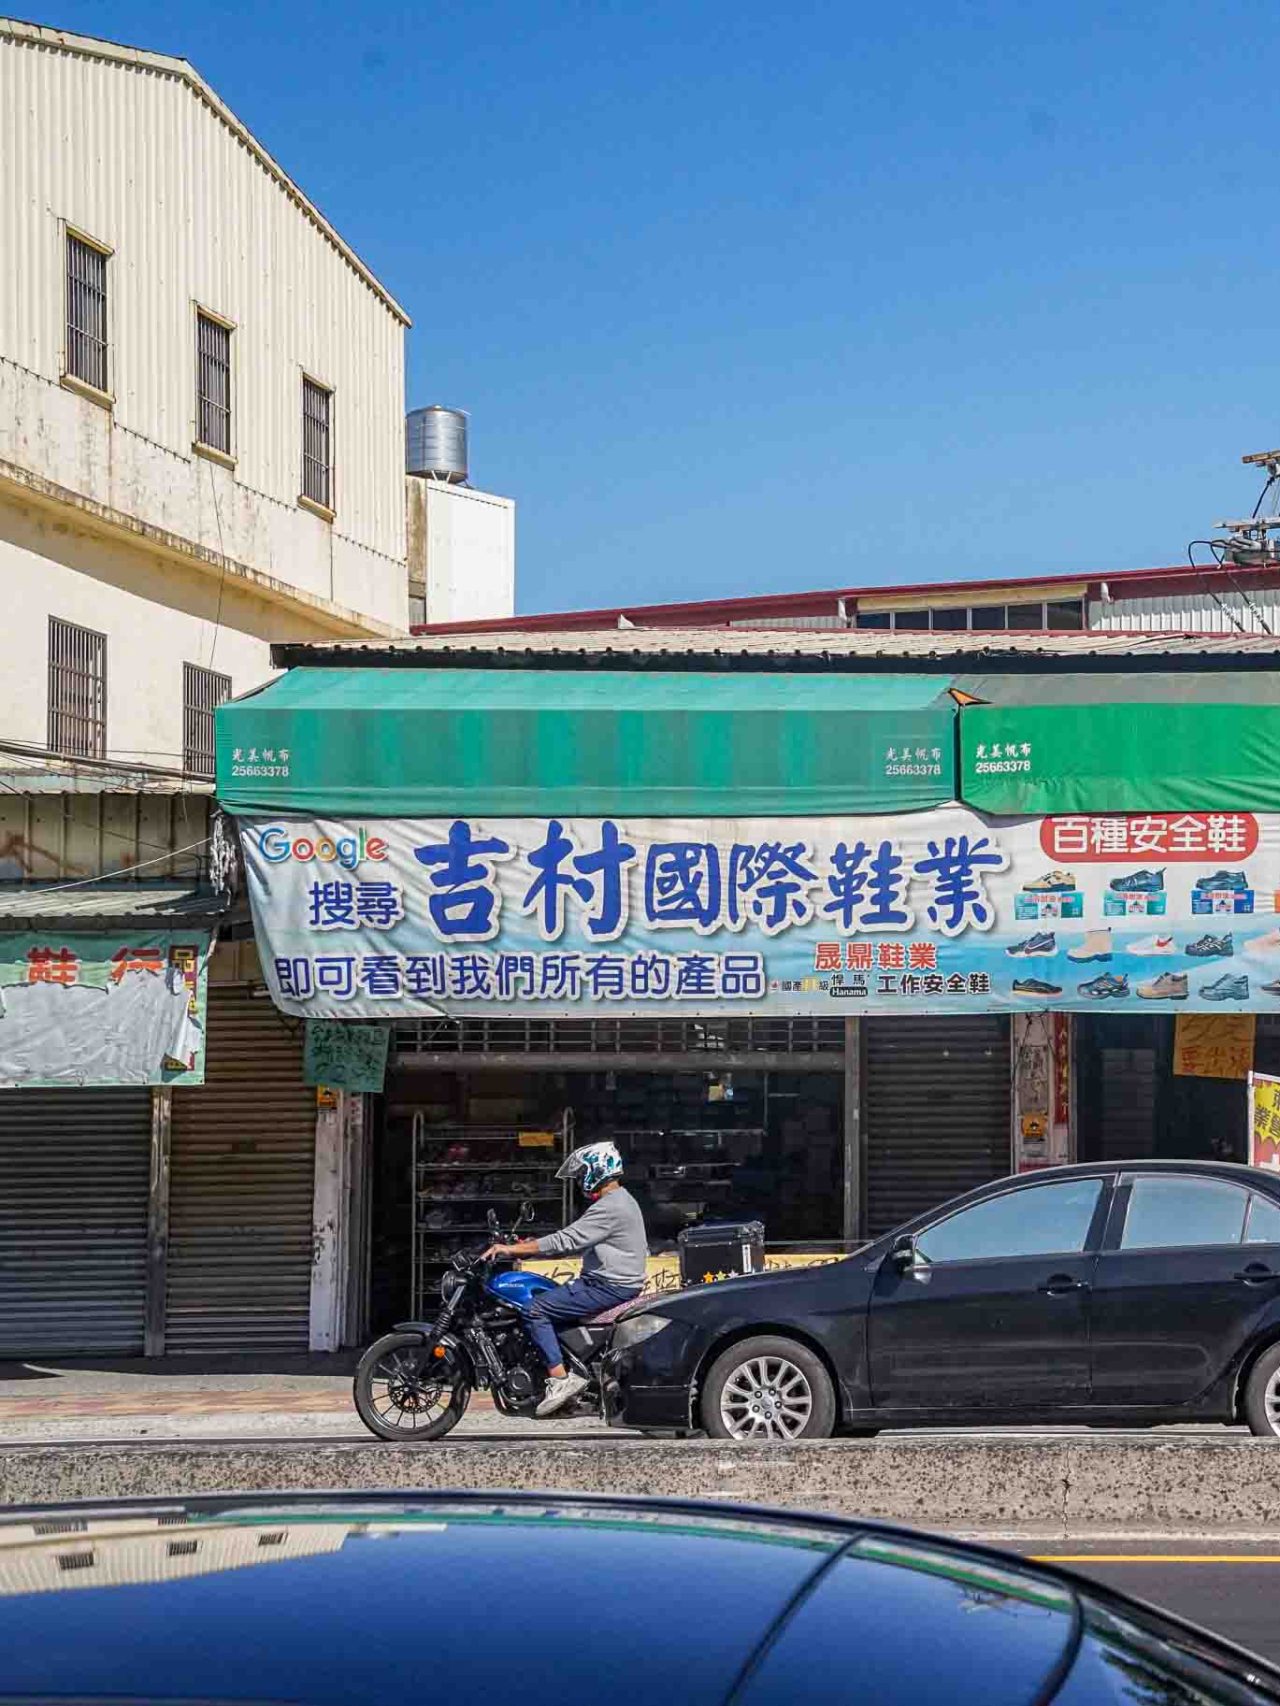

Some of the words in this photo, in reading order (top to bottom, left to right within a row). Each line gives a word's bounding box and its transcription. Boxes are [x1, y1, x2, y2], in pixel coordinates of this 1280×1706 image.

[231, 765, 289, 777] 25663378
[886, 764, 941, 775] 25663378
[975, 760, 1031, 773] 25663378
[258, 827, 389, 868] Google
[1052, 814, 1246, 855] 百種安全鞋
[412, 819, 1004, 936] 吉村國際鞋業
[308, 881, 398, 926] 搜尋
[815, 942, 937, 970] 晟鼎鞋業
[275, 954, 761, 997] 即可看到我們所有的產品
[876, 973, 991, 994] 工作安全鞋
